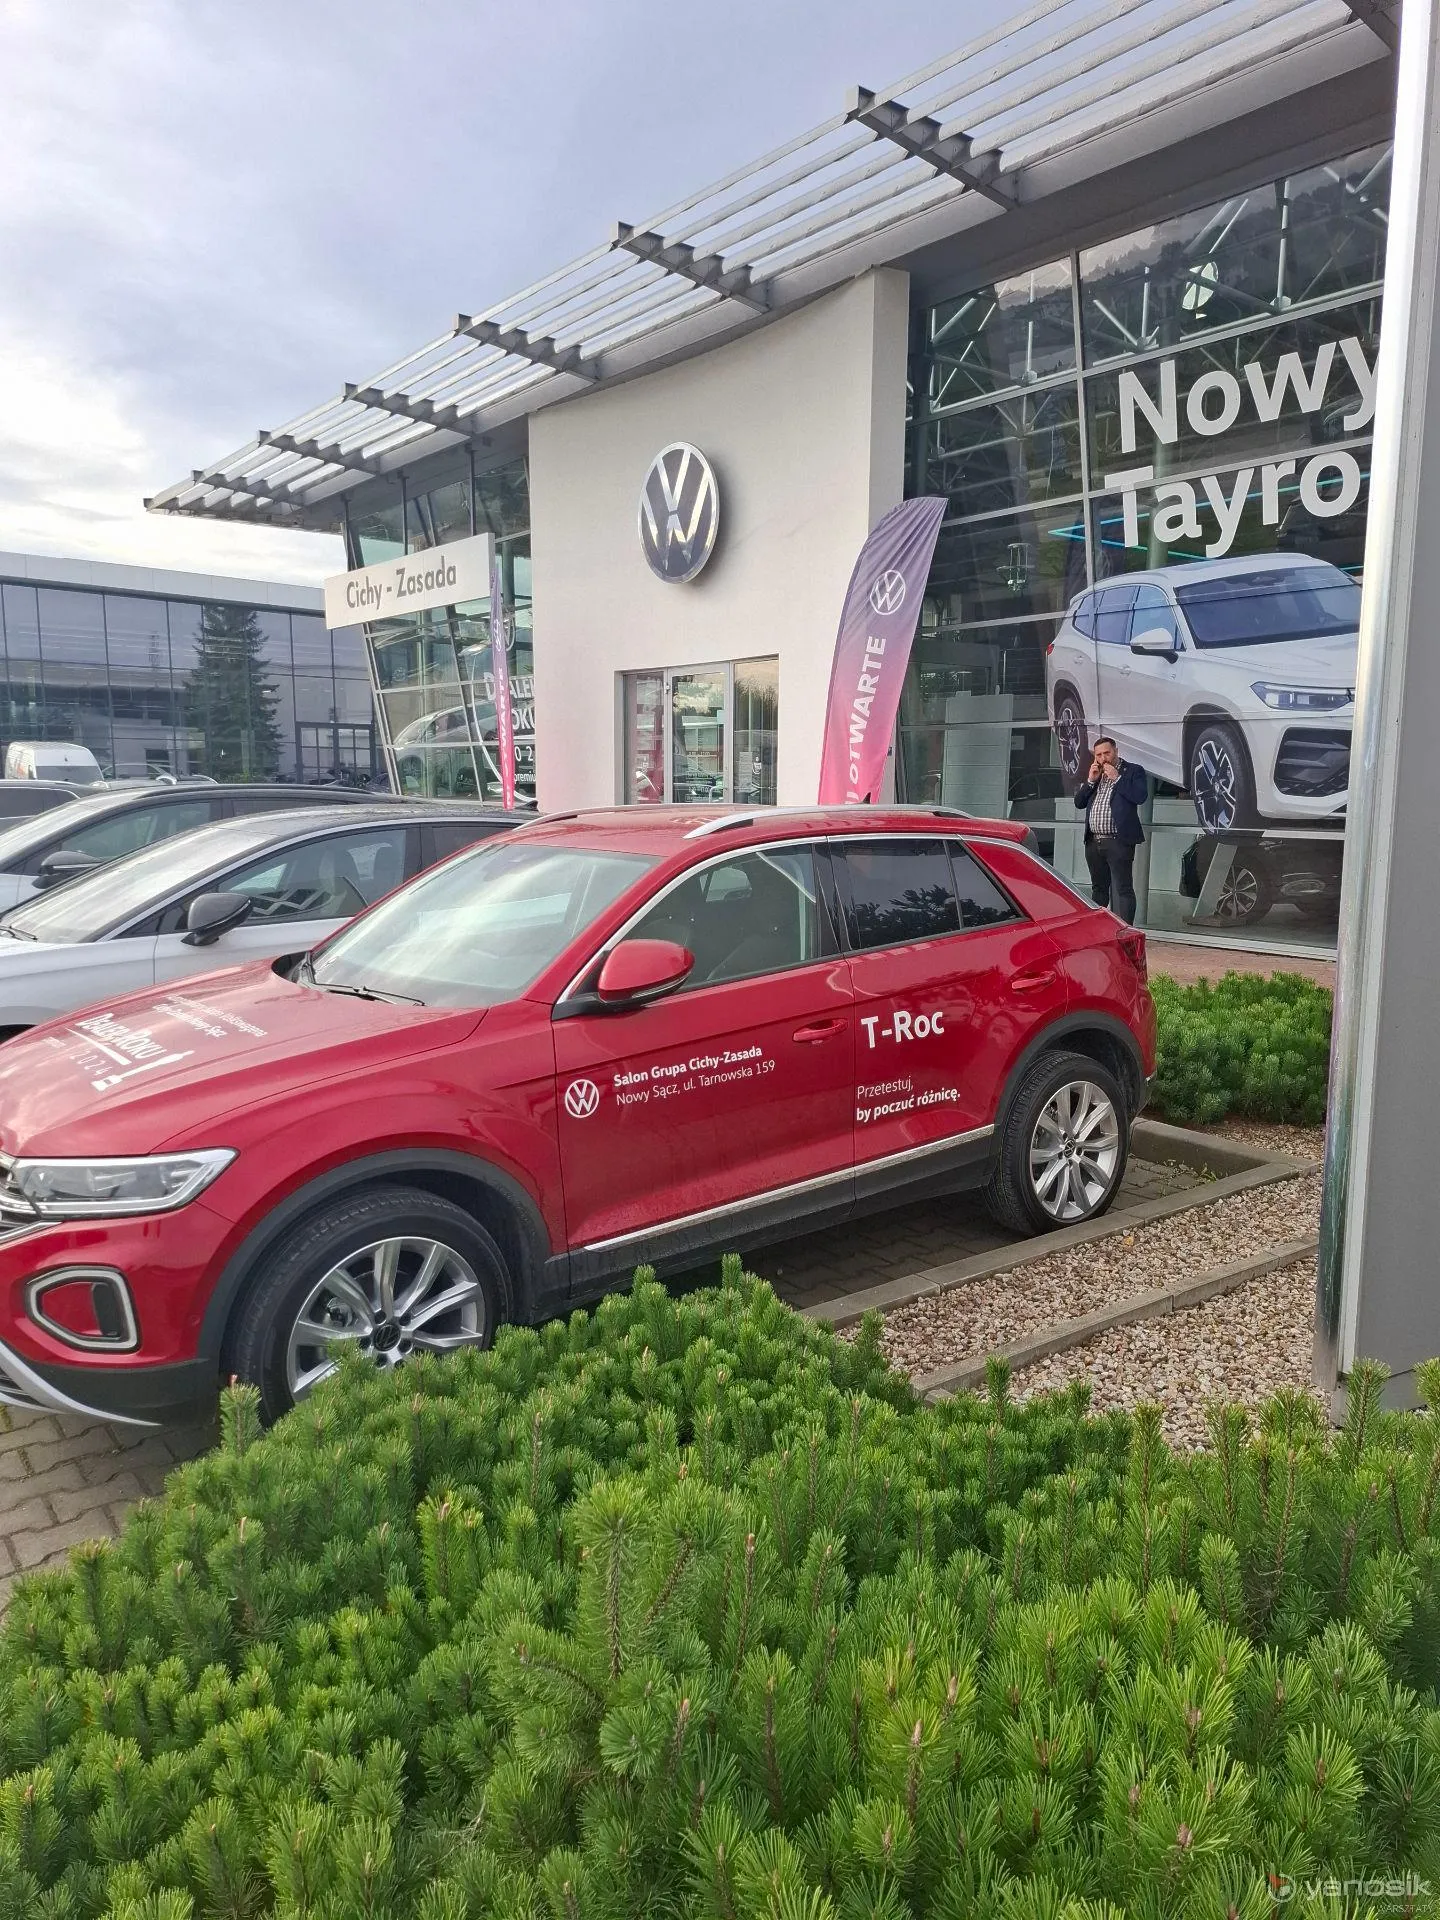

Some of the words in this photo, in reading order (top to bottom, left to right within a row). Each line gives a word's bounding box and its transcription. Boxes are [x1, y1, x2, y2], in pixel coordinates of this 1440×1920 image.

[1118, 336, 1380, 454] Nowy
[1104, 450, 1361, 558] Tayro
[346, 575, 383, 610] Cichy
[395, 555, 457, 598] Zasada
[850, 636, 887, 785] OTWARTE
[860, 1010, 945, 1049] T-Roc
[613, 1070, 649, 1087] Salon
[651, 1063, 687, 1079] Grupa
[689, 1045, 763, 1071] Cichy-Zasada
[616, 1089, 650, 1106] Nowy
[652, 1082, 681, 1099] Sącz,
[683, 1078, 696, 1091] ul.
[698, 1066, 753, 1087] Tarnowska
[755, 1059, 776, 1075] 159
[857, 1075, 914, 1100] Przetestuj,
[856, 1107, 872, 1123] by
[873, 1094, 915, 1120] poczuć
[917, 1087, 961, 1107] różnicę.
